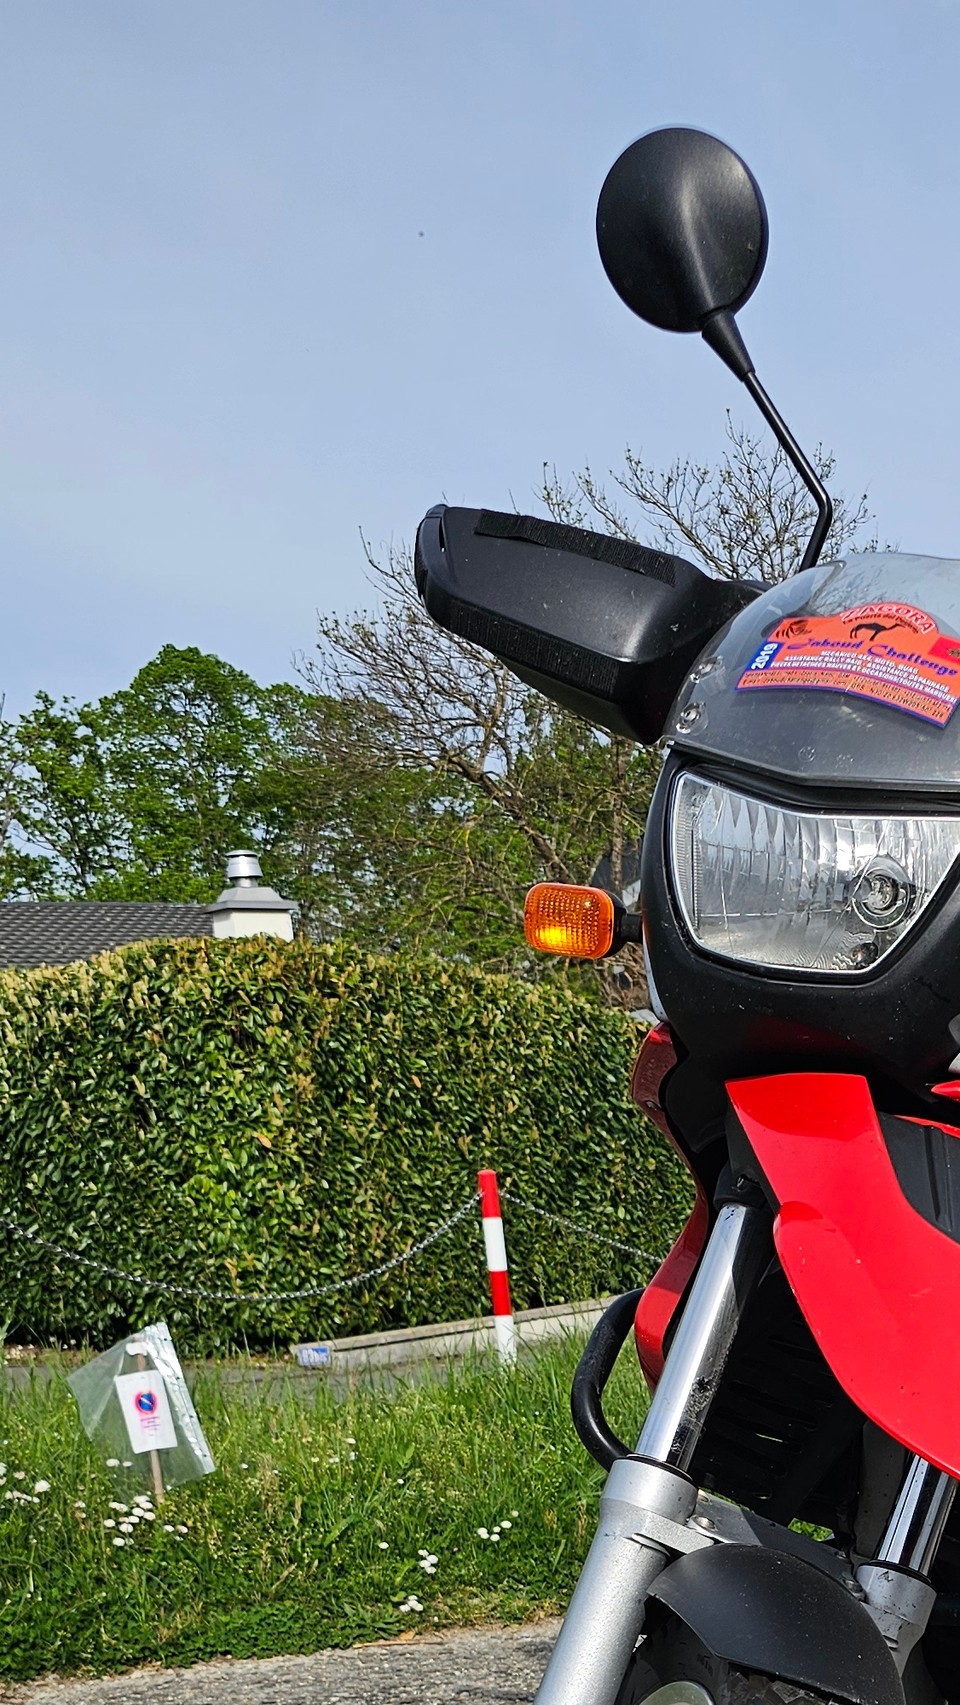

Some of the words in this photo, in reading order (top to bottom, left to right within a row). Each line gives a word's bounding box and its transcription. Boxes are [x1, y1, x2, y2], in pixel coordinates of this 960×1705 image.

[840, 604, 936, 634] ZAGORA
[750, 642, 779, 670] 2019
[866, 662, 909, 679] ASSISTANCE
[867, 643, 958, 676] Challenge
